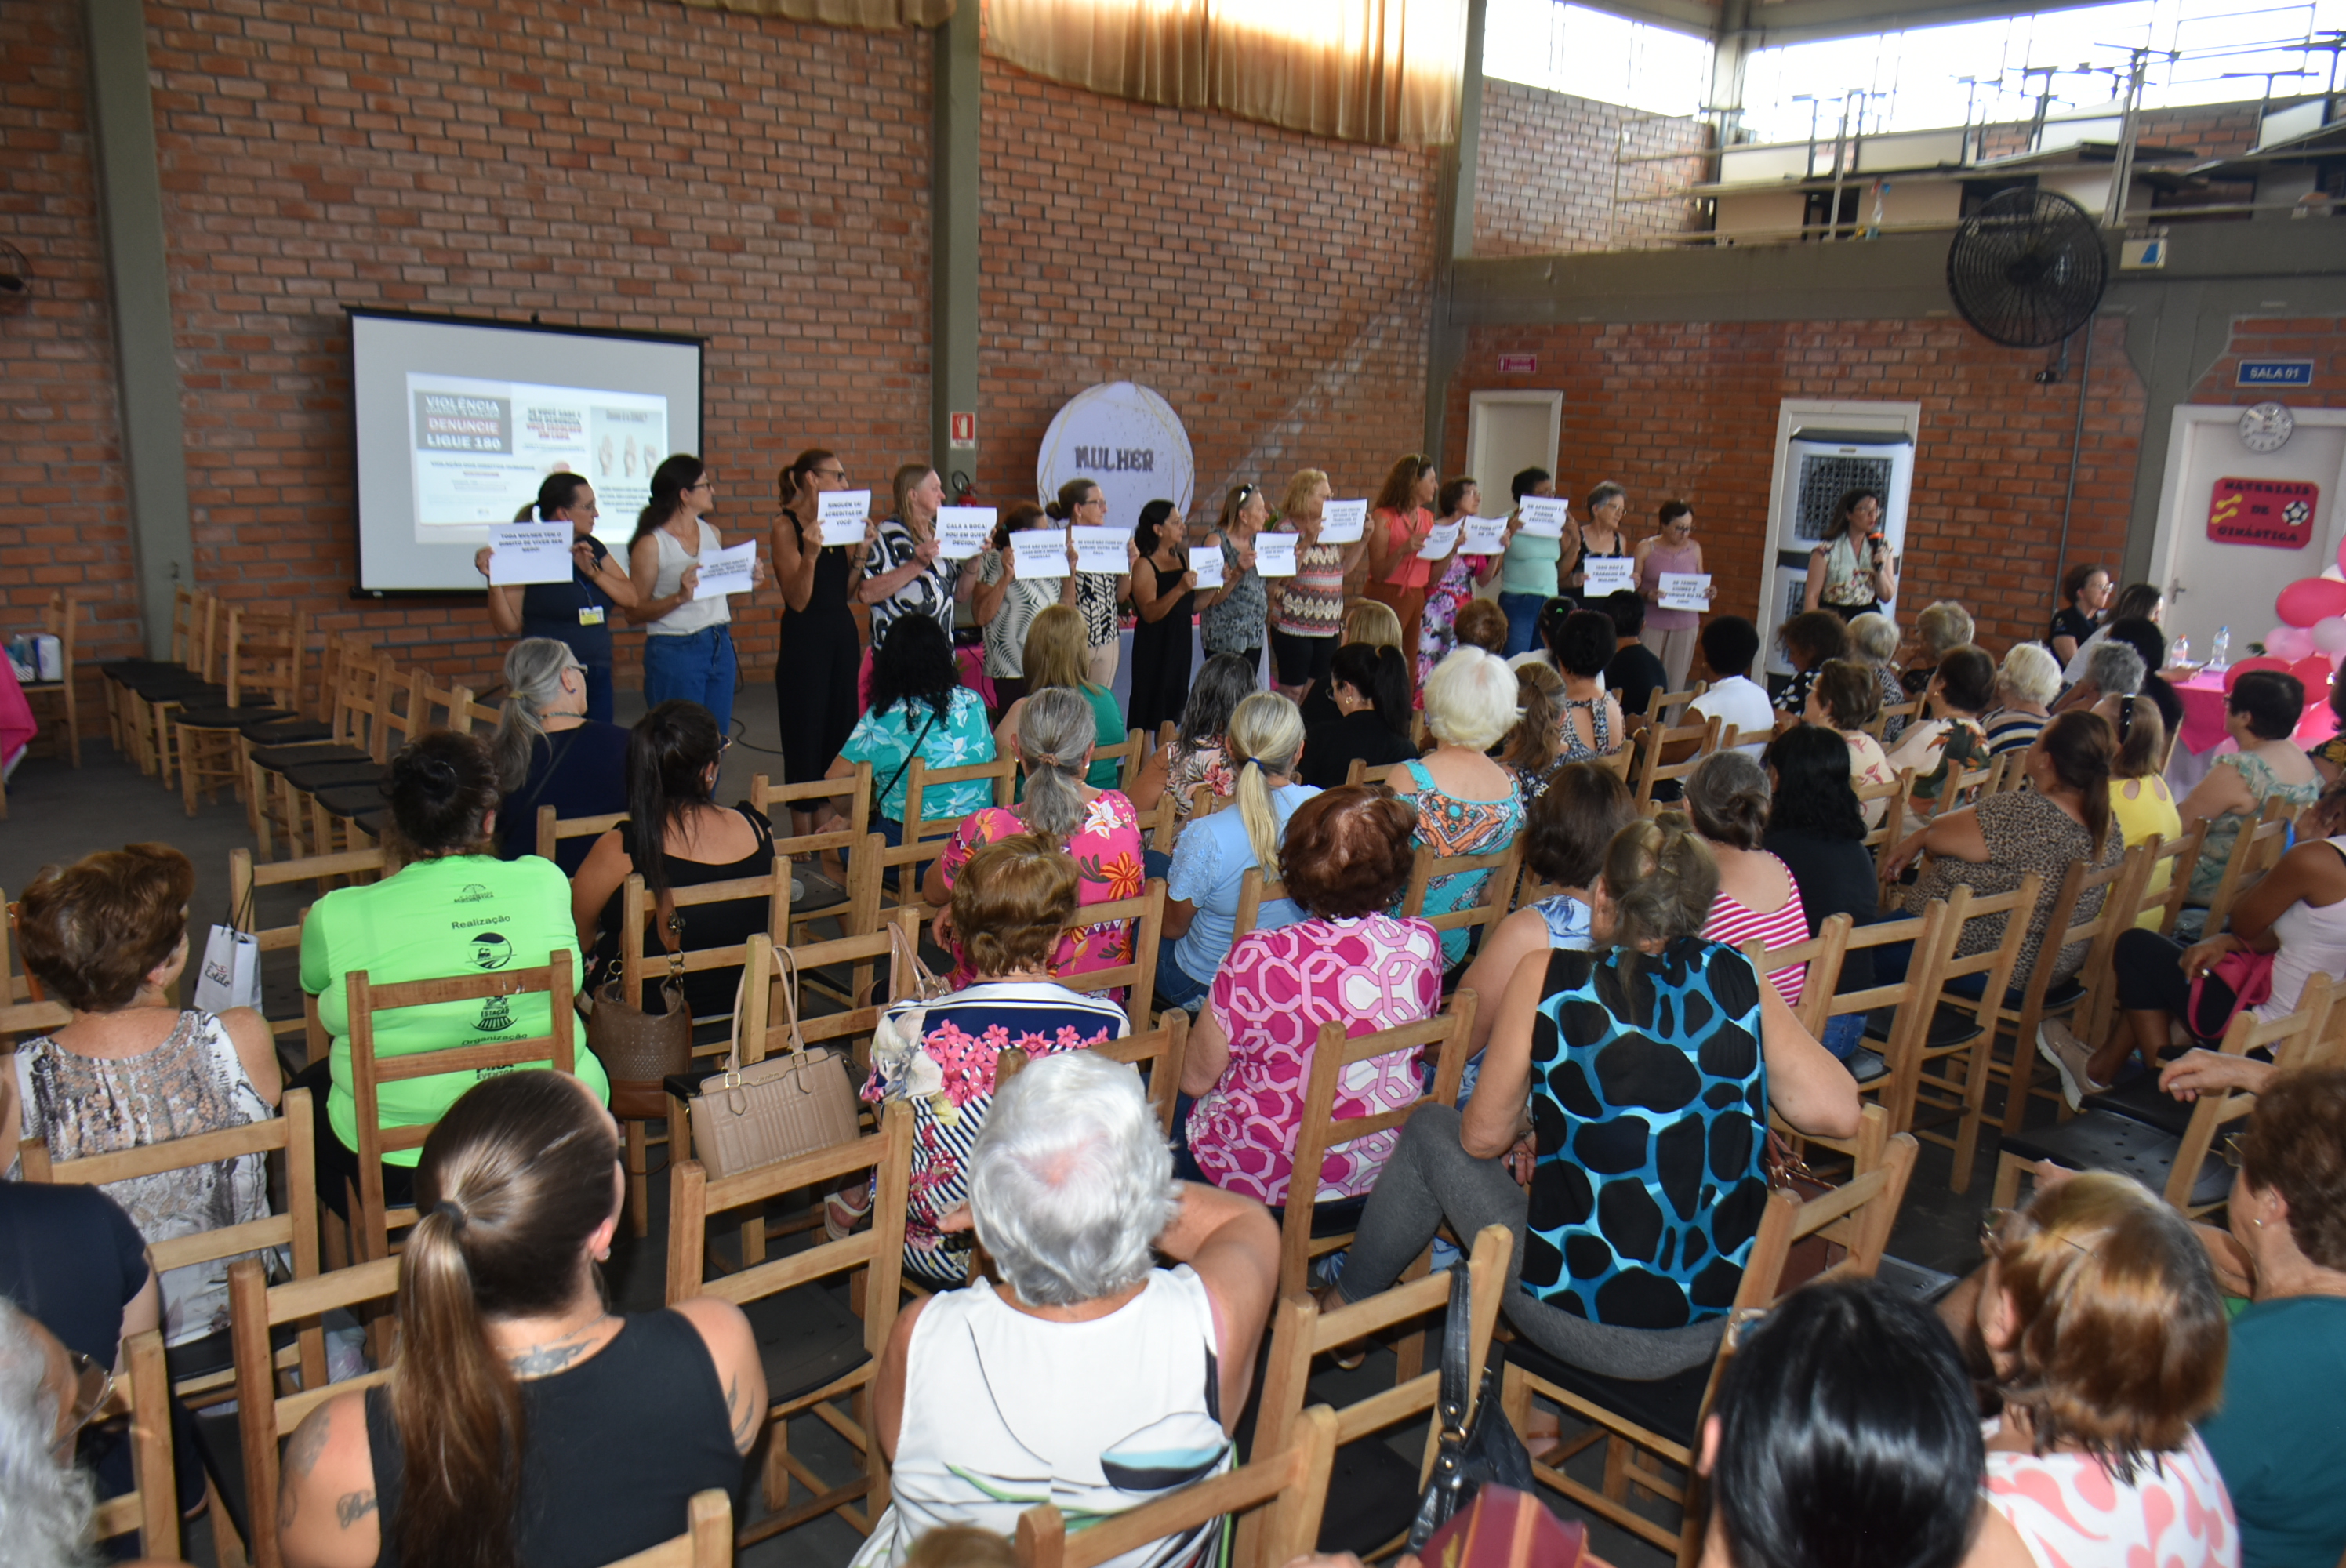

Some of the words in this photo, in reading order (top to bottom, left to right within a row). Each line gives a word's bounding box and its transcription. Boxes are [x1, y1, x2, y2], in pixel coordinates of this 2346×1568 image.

[2249, 366, 2284, 380] SALA
[2285, 367, 2300, 380] 01
[425, 395, 500, 411] VIOLÊNCIA
[428, 417, 500, 435] DENUNCIE
[426, 433, 472, 450] LIGUE
[474, 436, 503, 451] 180
[1074, 445, 1154, 473] MULHER
[2225, 481, 2310, 495] MATERIAIS
[2251, 505, 2269, 514] DE
[451, 915, 511, 929] Realização
[480, 1007, 510, 1017] ESTAÇÃO
[461, 1033, 528, 1045] Organização
